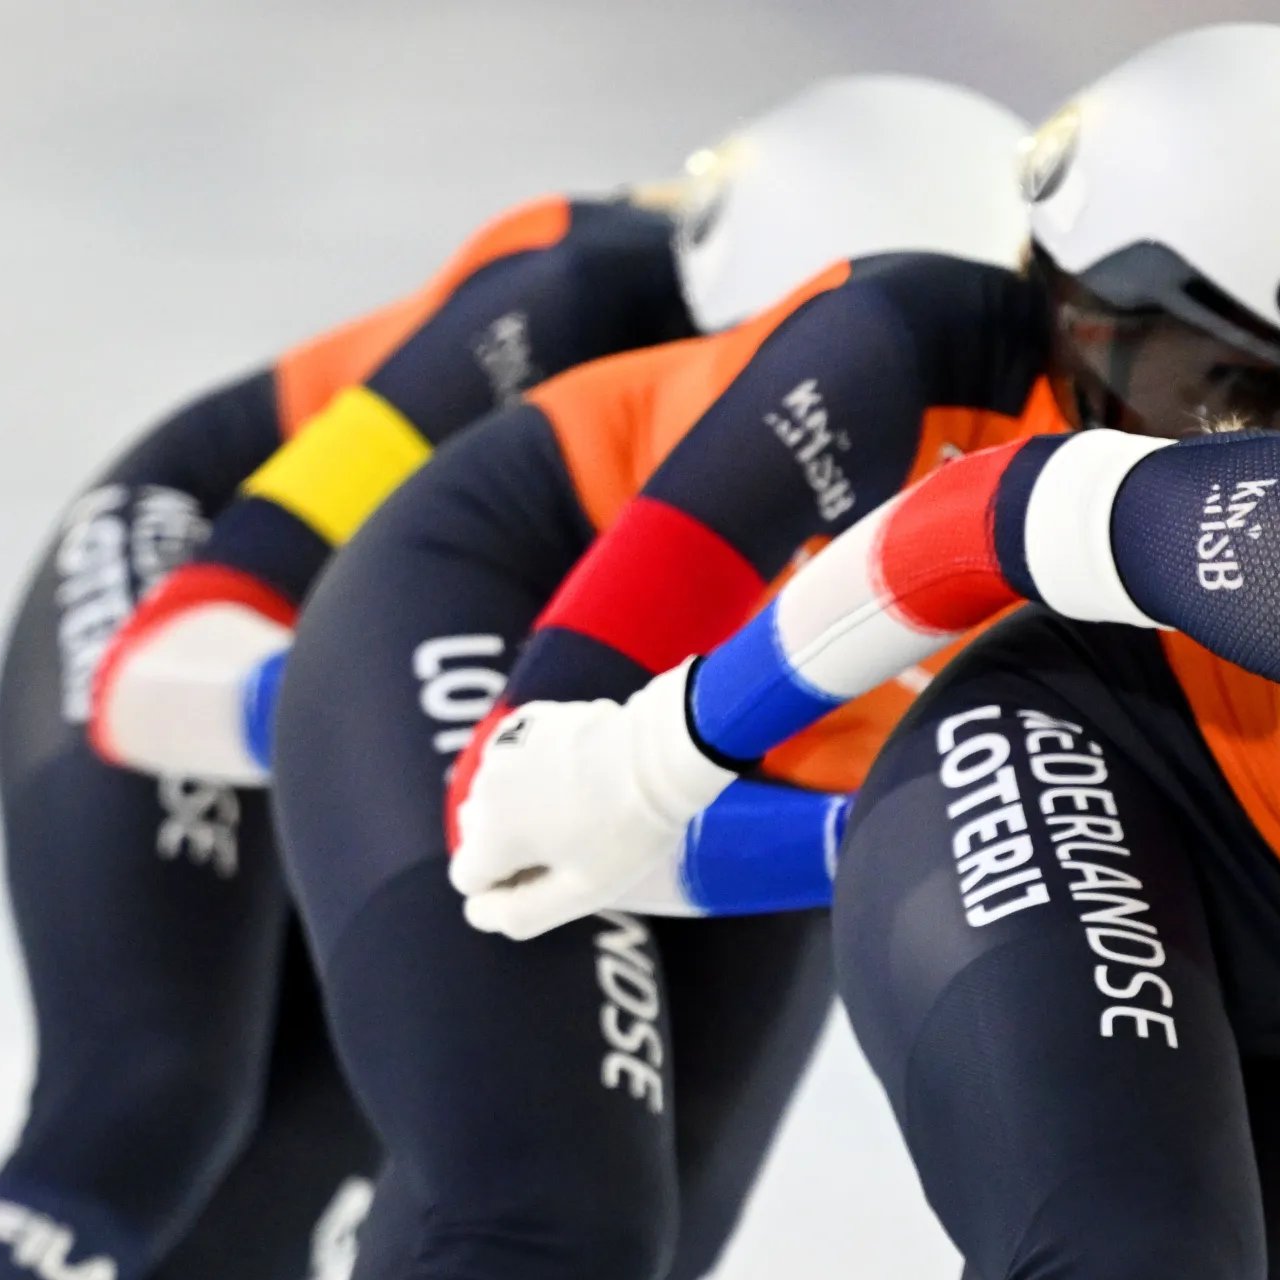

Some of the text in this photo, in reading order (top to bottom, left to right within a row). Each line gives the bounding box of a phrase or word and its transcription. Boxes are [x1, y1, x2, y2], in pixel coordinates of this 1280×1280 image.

[936, 704, 1051, 928] LOTERIJ
[1016, 708, 1179, 1050] NEDERLANDSE
[594, 908, 664, 1115] NDSE
